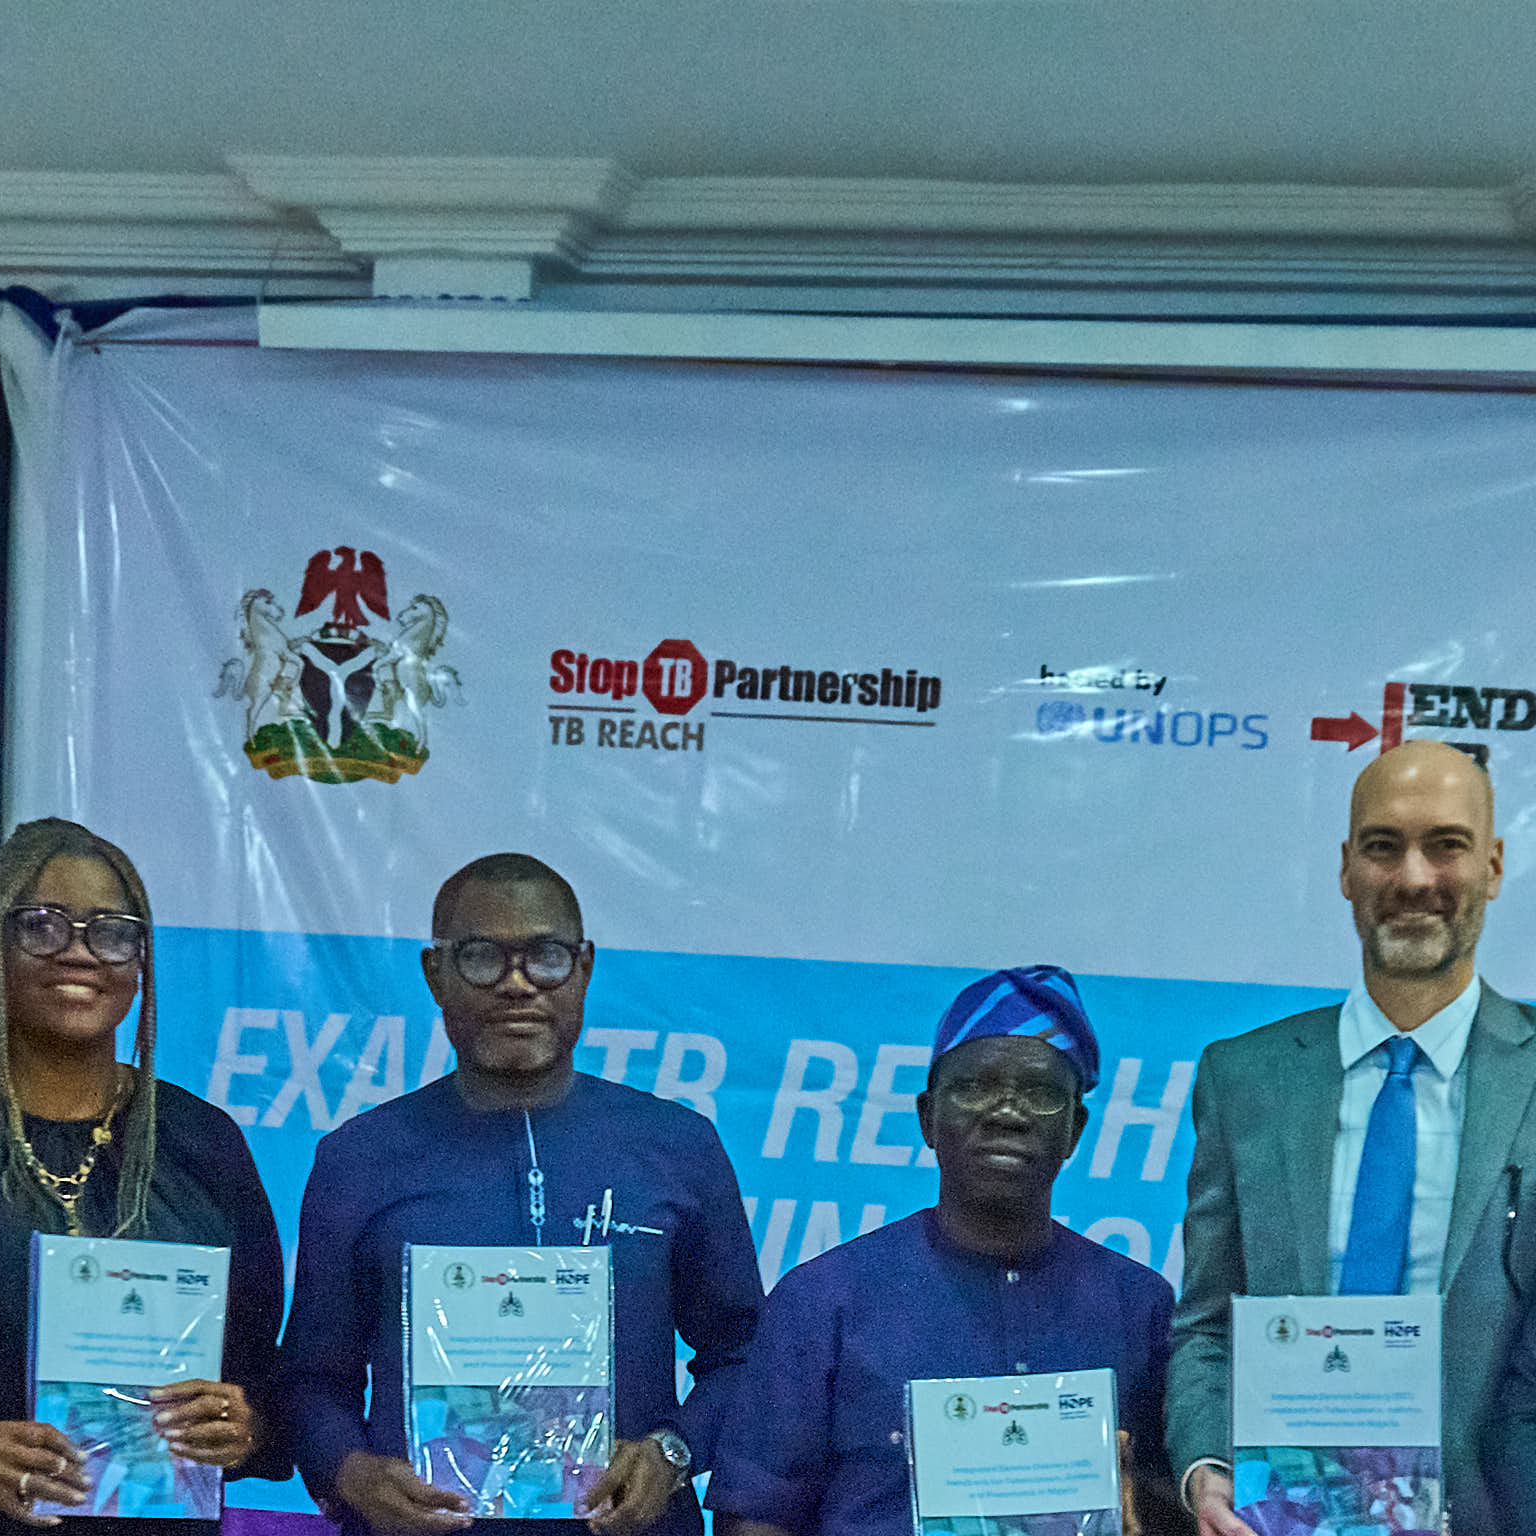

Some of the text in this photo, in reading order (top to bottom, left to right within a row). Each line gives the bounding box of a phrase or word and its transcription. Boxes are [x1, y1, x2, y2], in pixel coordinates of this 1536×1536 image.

[549, 649, 942, 712] Stop TB Partnership
[549, 716, 706, 751] TB REACH
[1094, 707, 1269, 750] UNOPS
[762, 1039, 1196, 1181] REH
